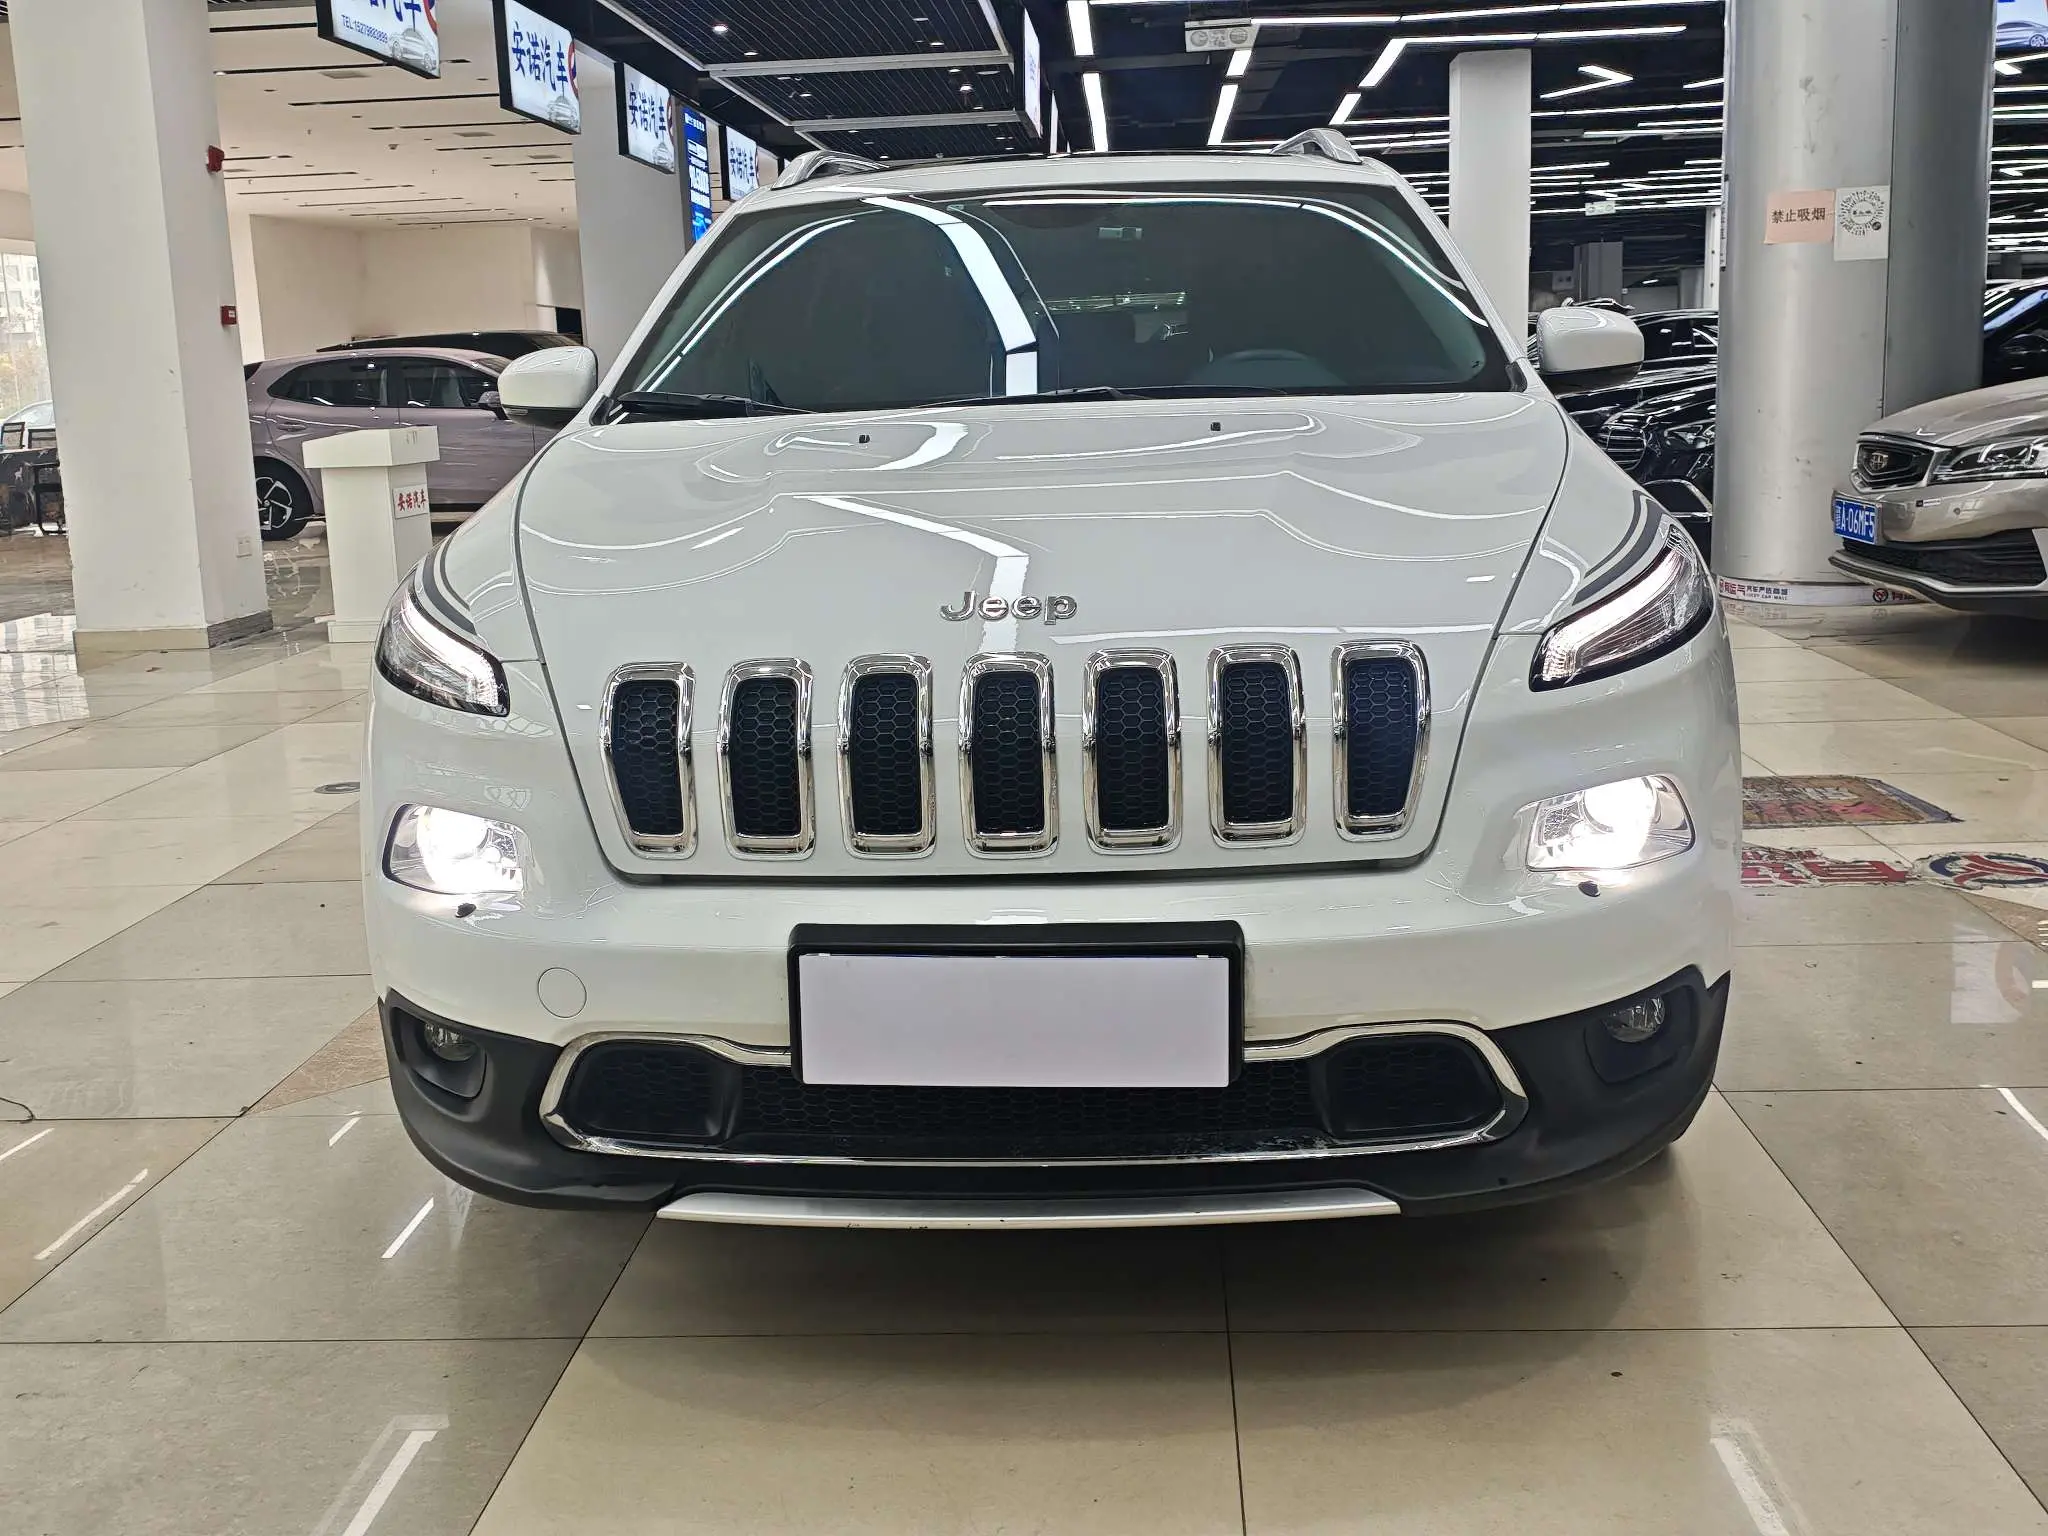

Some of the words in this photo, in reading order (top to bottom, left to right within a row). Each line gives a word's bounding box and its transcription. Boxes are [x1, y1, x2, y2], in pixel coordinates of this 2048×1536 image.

[512, 21, 568, 97] 安诺汽车
[1771, 207, 1826, 224] 禁止吸烟
[938, 590, 1078, 626] Jeep
